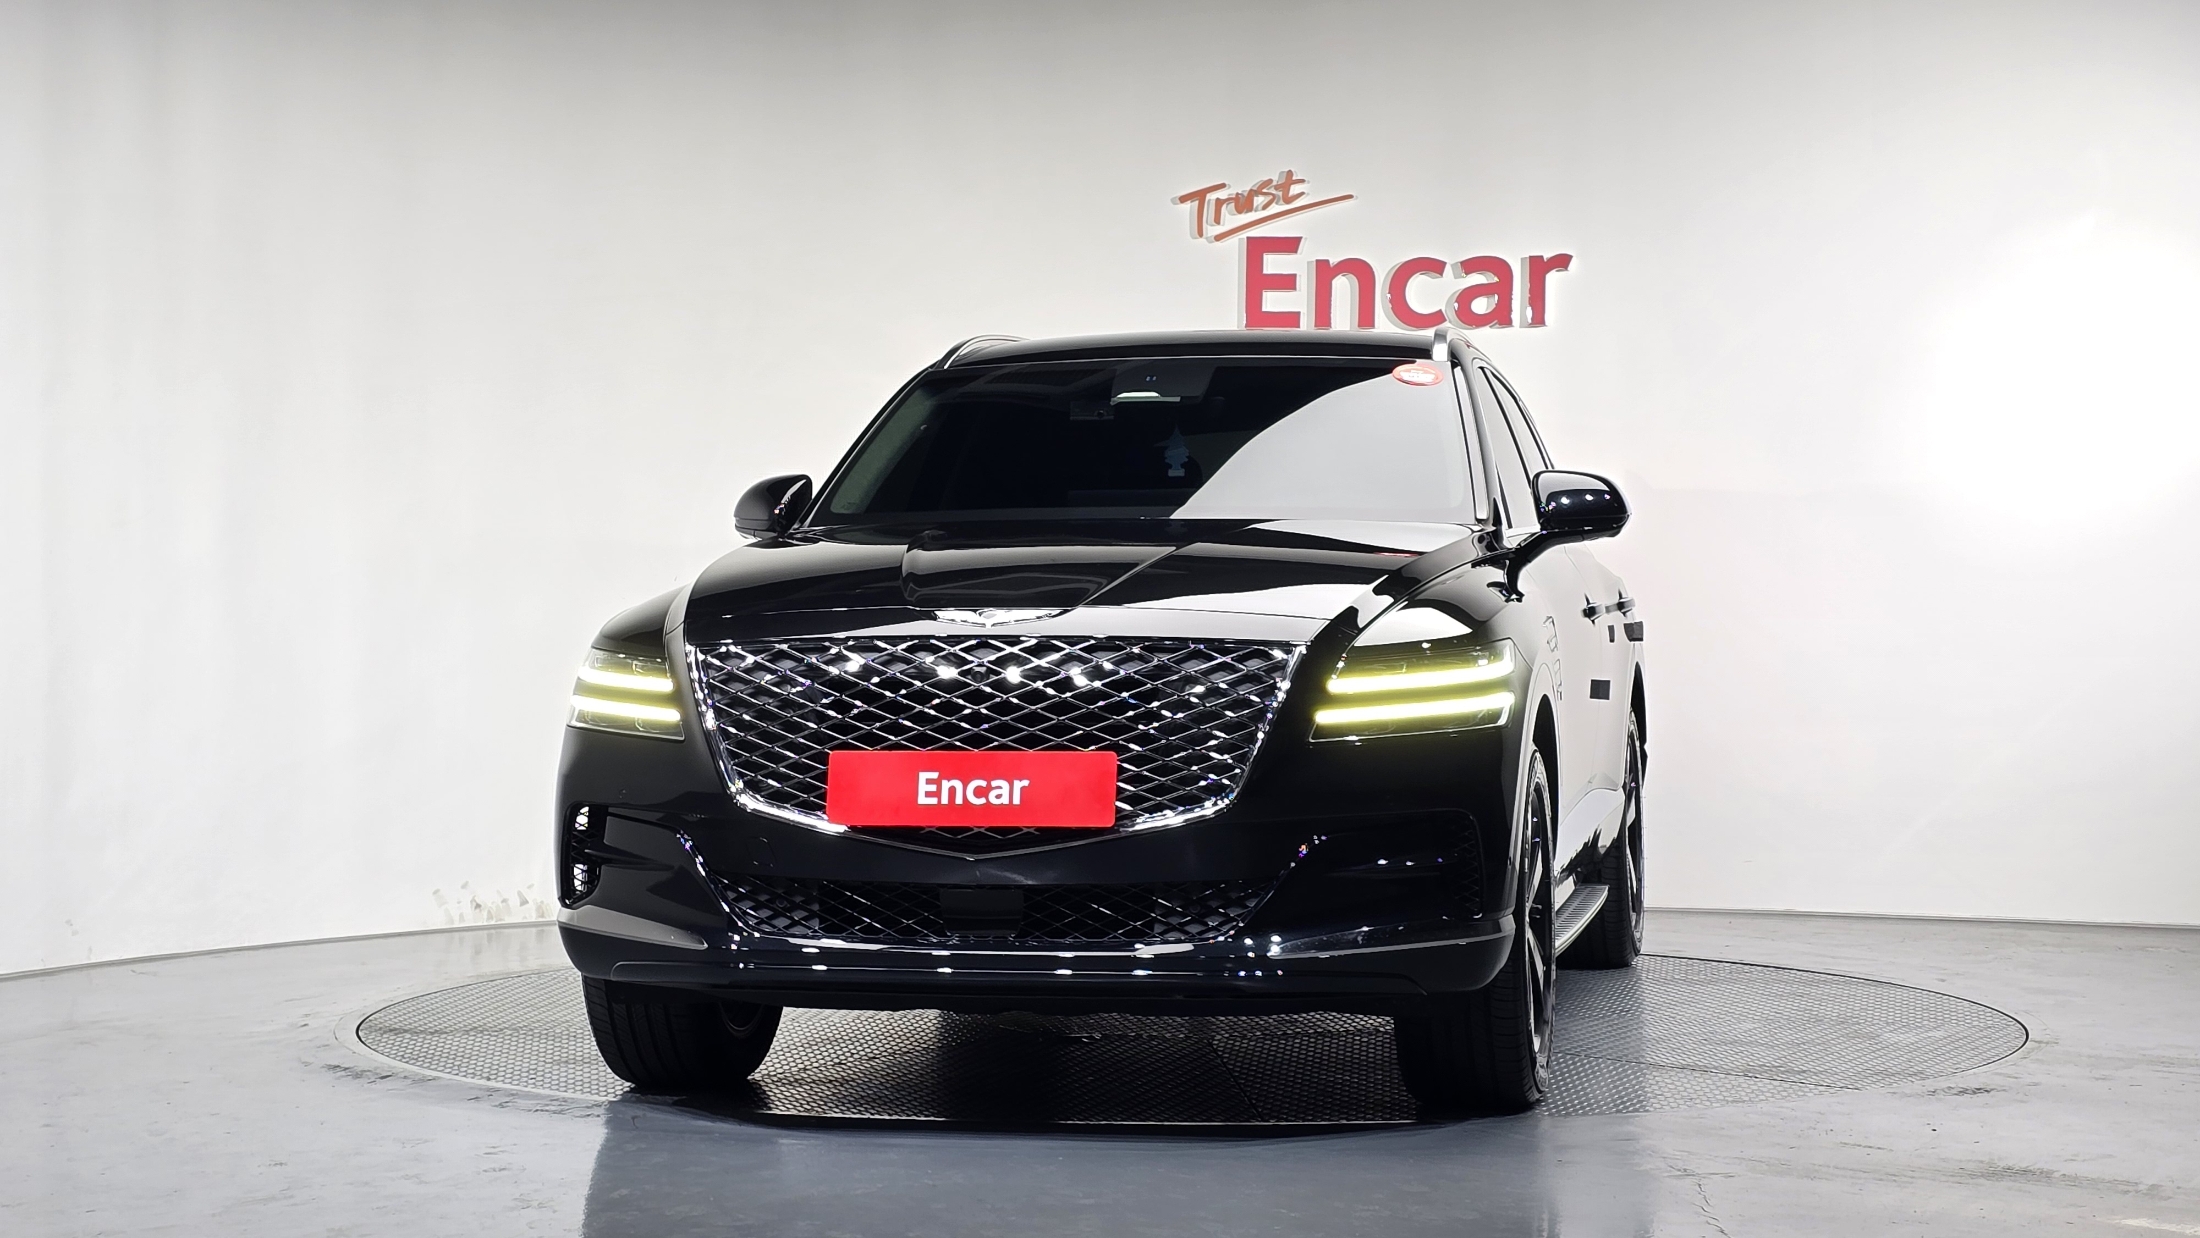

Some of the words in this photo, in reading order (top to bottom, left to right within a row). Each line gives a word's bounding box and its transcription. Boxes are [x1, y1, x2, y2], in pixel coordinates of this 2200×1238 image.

[1178, 169, 1306, 239] Trust
[1245, 236, 1574, 329] Encar
[917, 771, 1030, 805] Encar
